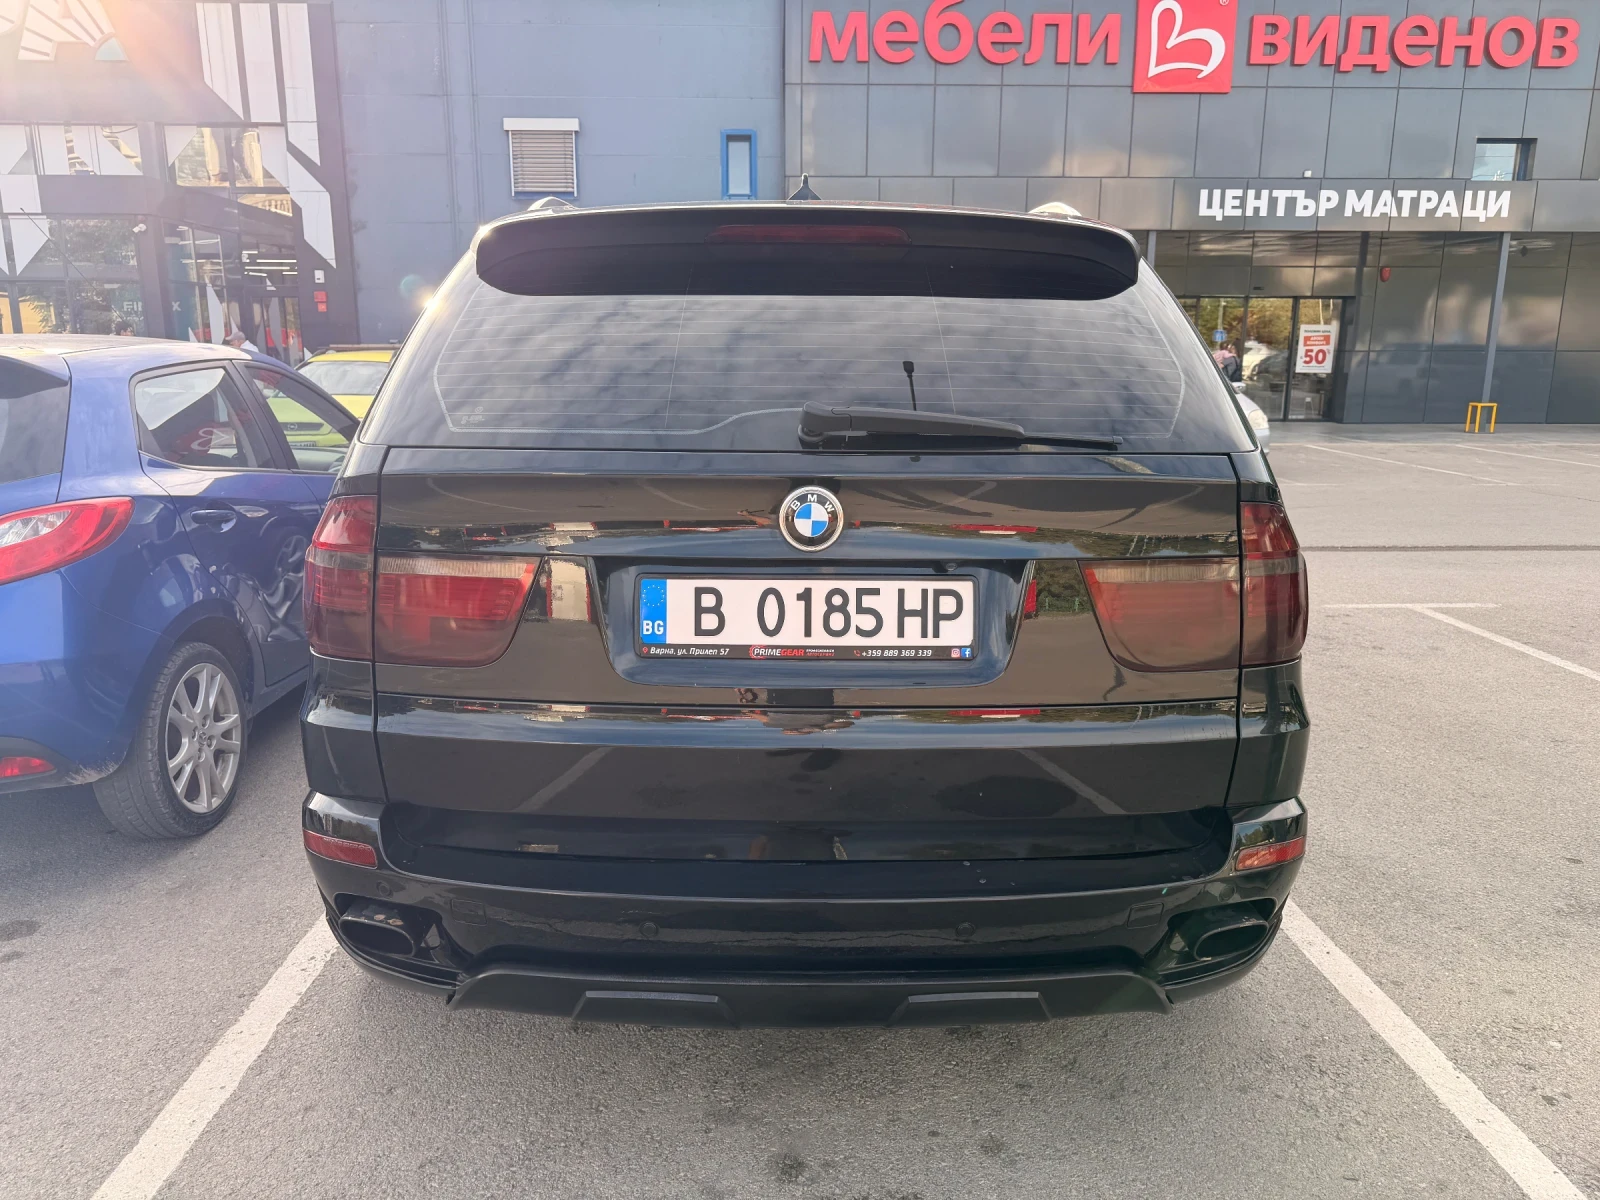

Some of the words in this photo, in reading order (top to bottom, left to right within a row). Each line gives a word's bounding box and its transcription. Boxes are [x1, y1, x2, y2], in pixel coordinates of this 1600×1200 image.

[808, 0, 1122, 65] мебели
[1247, 14, 1580, 73] виденов
[1198, 188, 1340, 221] ЦЕНТЪР
[1343, 189, 1511, 222] МАТРАЦИ
[790, 493, 835, 513] BMW
[694, 586, 726, 637] B
[757, 587, 884, 638] 0185
[897, 588, 964, 639] HP
[642, 620, 664, 635] BG
[689, 647, 718, 656] Прилеп
[720, 648, 730, 656] 57
[754, 648, 805, 656] PRIMEGEAR
[861, 649, 882, 657] +359
[883, 649, 899, 657] 889
[900, 649, 916, 657] 369
[917, 649, 933, 657] 339
